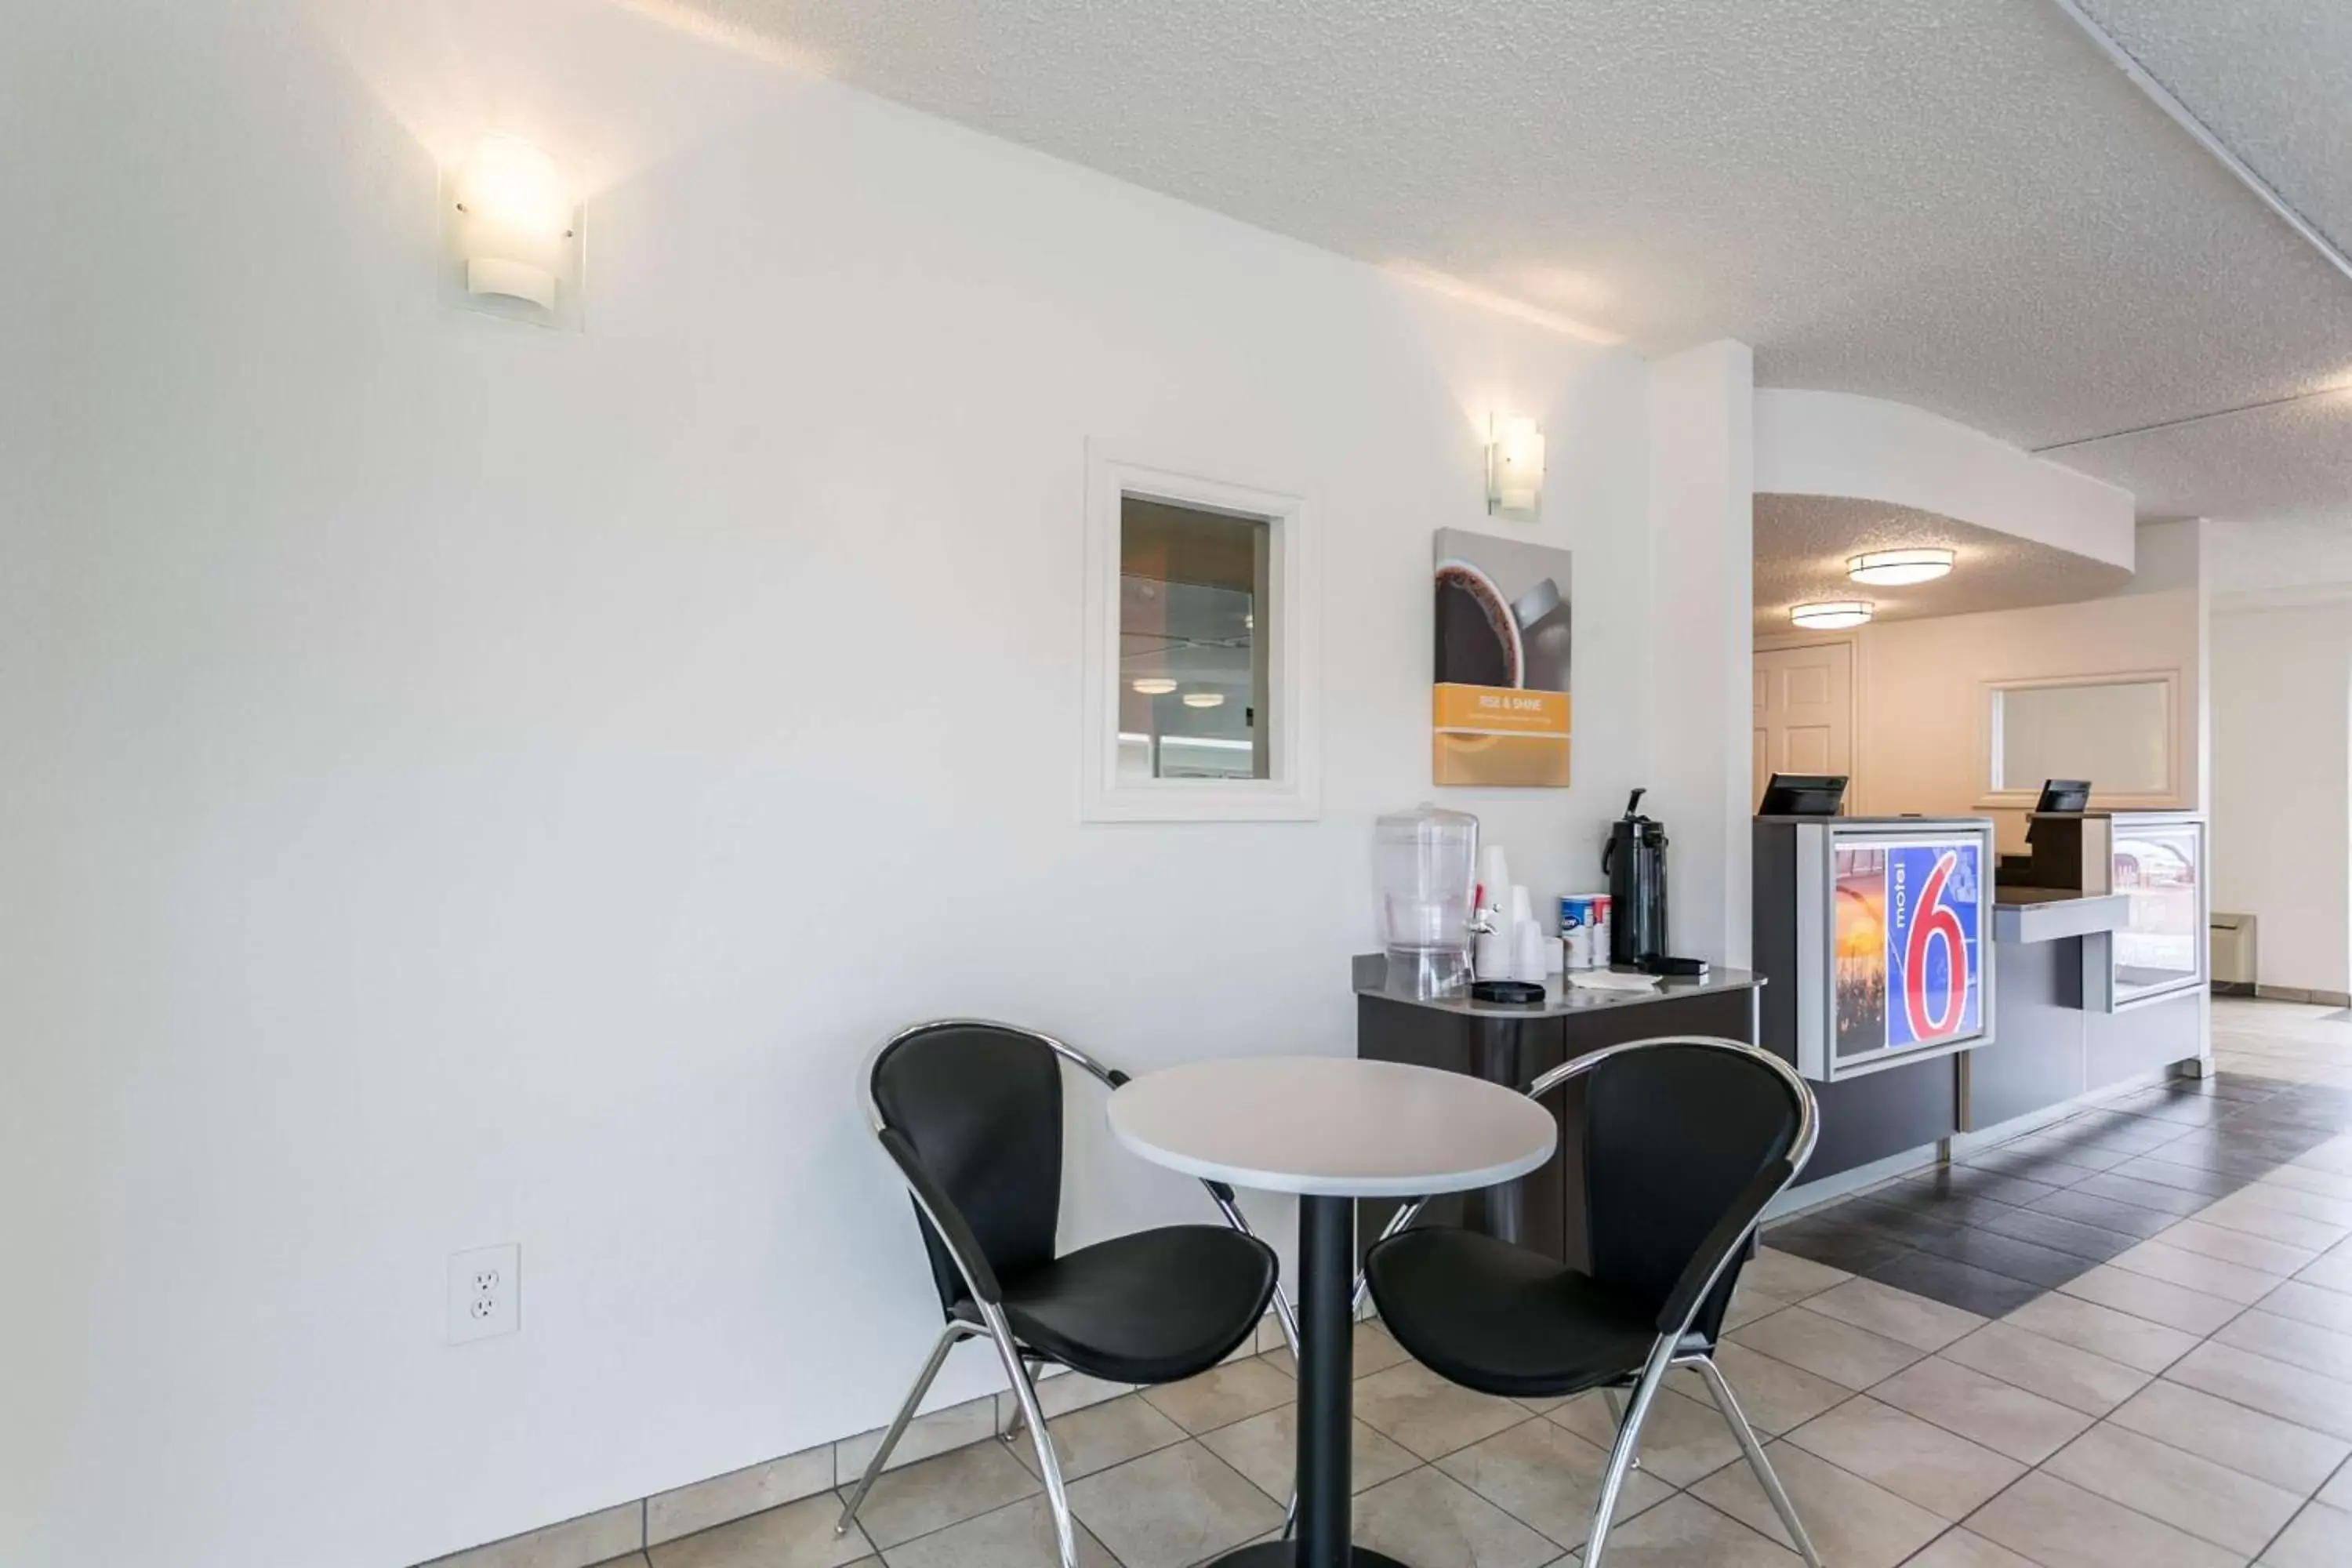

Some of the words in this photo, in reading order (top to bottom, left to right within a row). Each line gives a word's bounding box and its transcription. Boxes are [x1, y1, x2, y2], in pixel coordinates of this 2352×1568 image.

[1479, 695, 1501, 708] RISE
[1503, 696, 1511, 710] &
[1512, 697, 1541, 711] SHINE
[1894, 863, 1906, 928] motel
[1904, 850, 1968, 1041] 6
